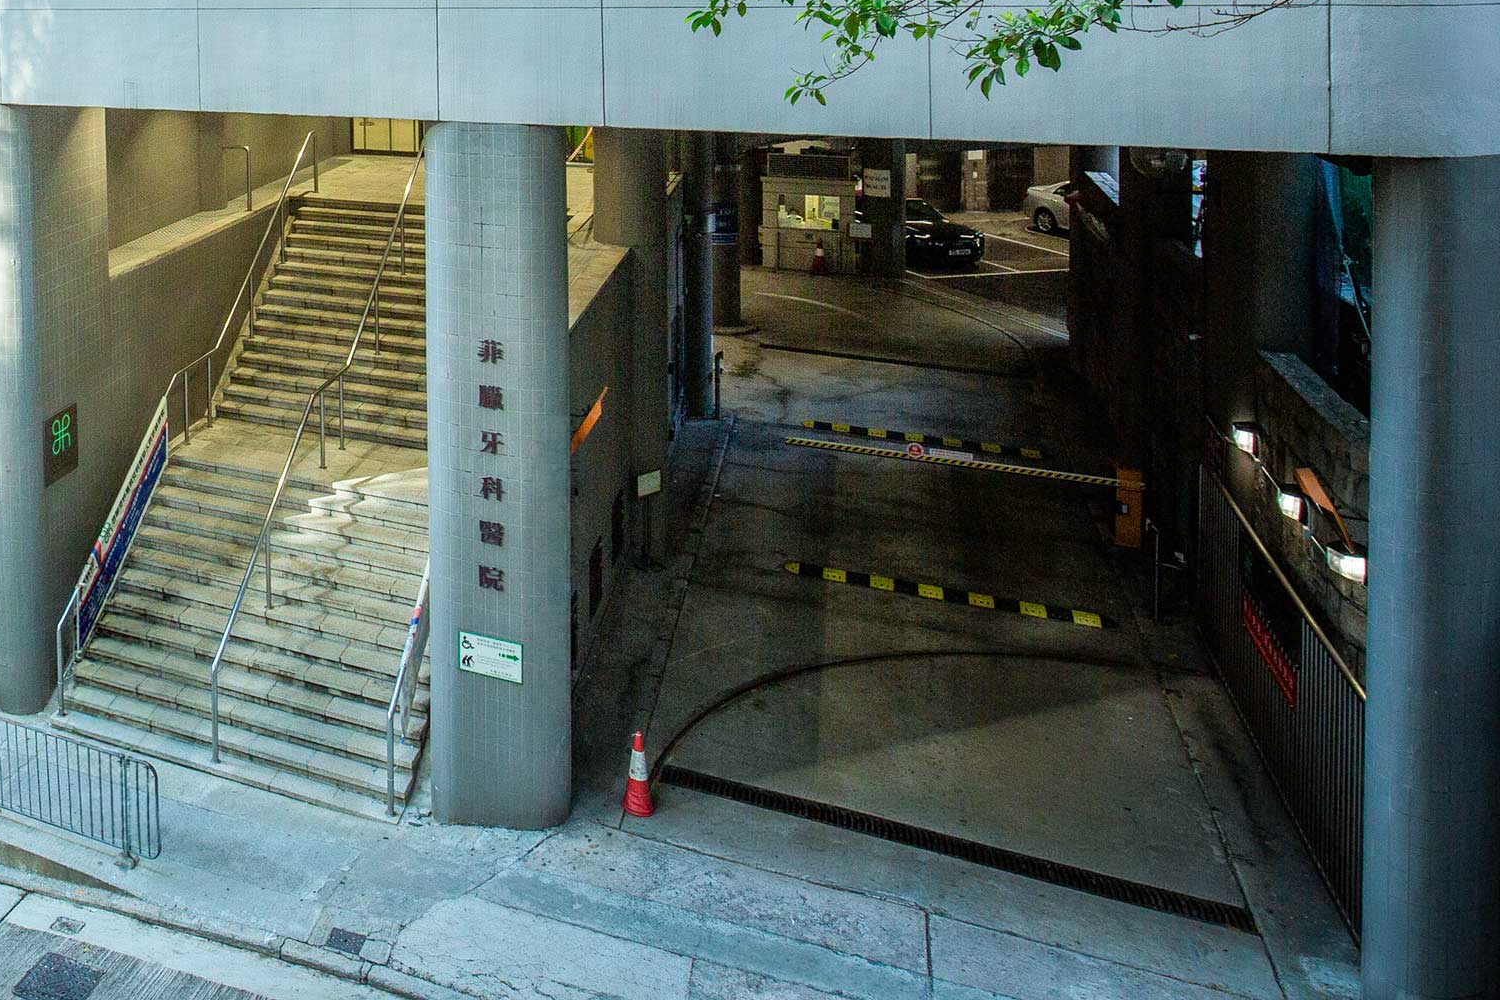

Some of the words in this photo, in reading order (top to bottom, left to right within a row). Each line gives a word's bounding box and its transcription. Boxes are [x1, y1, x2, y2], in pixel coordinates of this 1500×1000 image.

[477, 339, 506, 592] 菲臘牙科醫院
